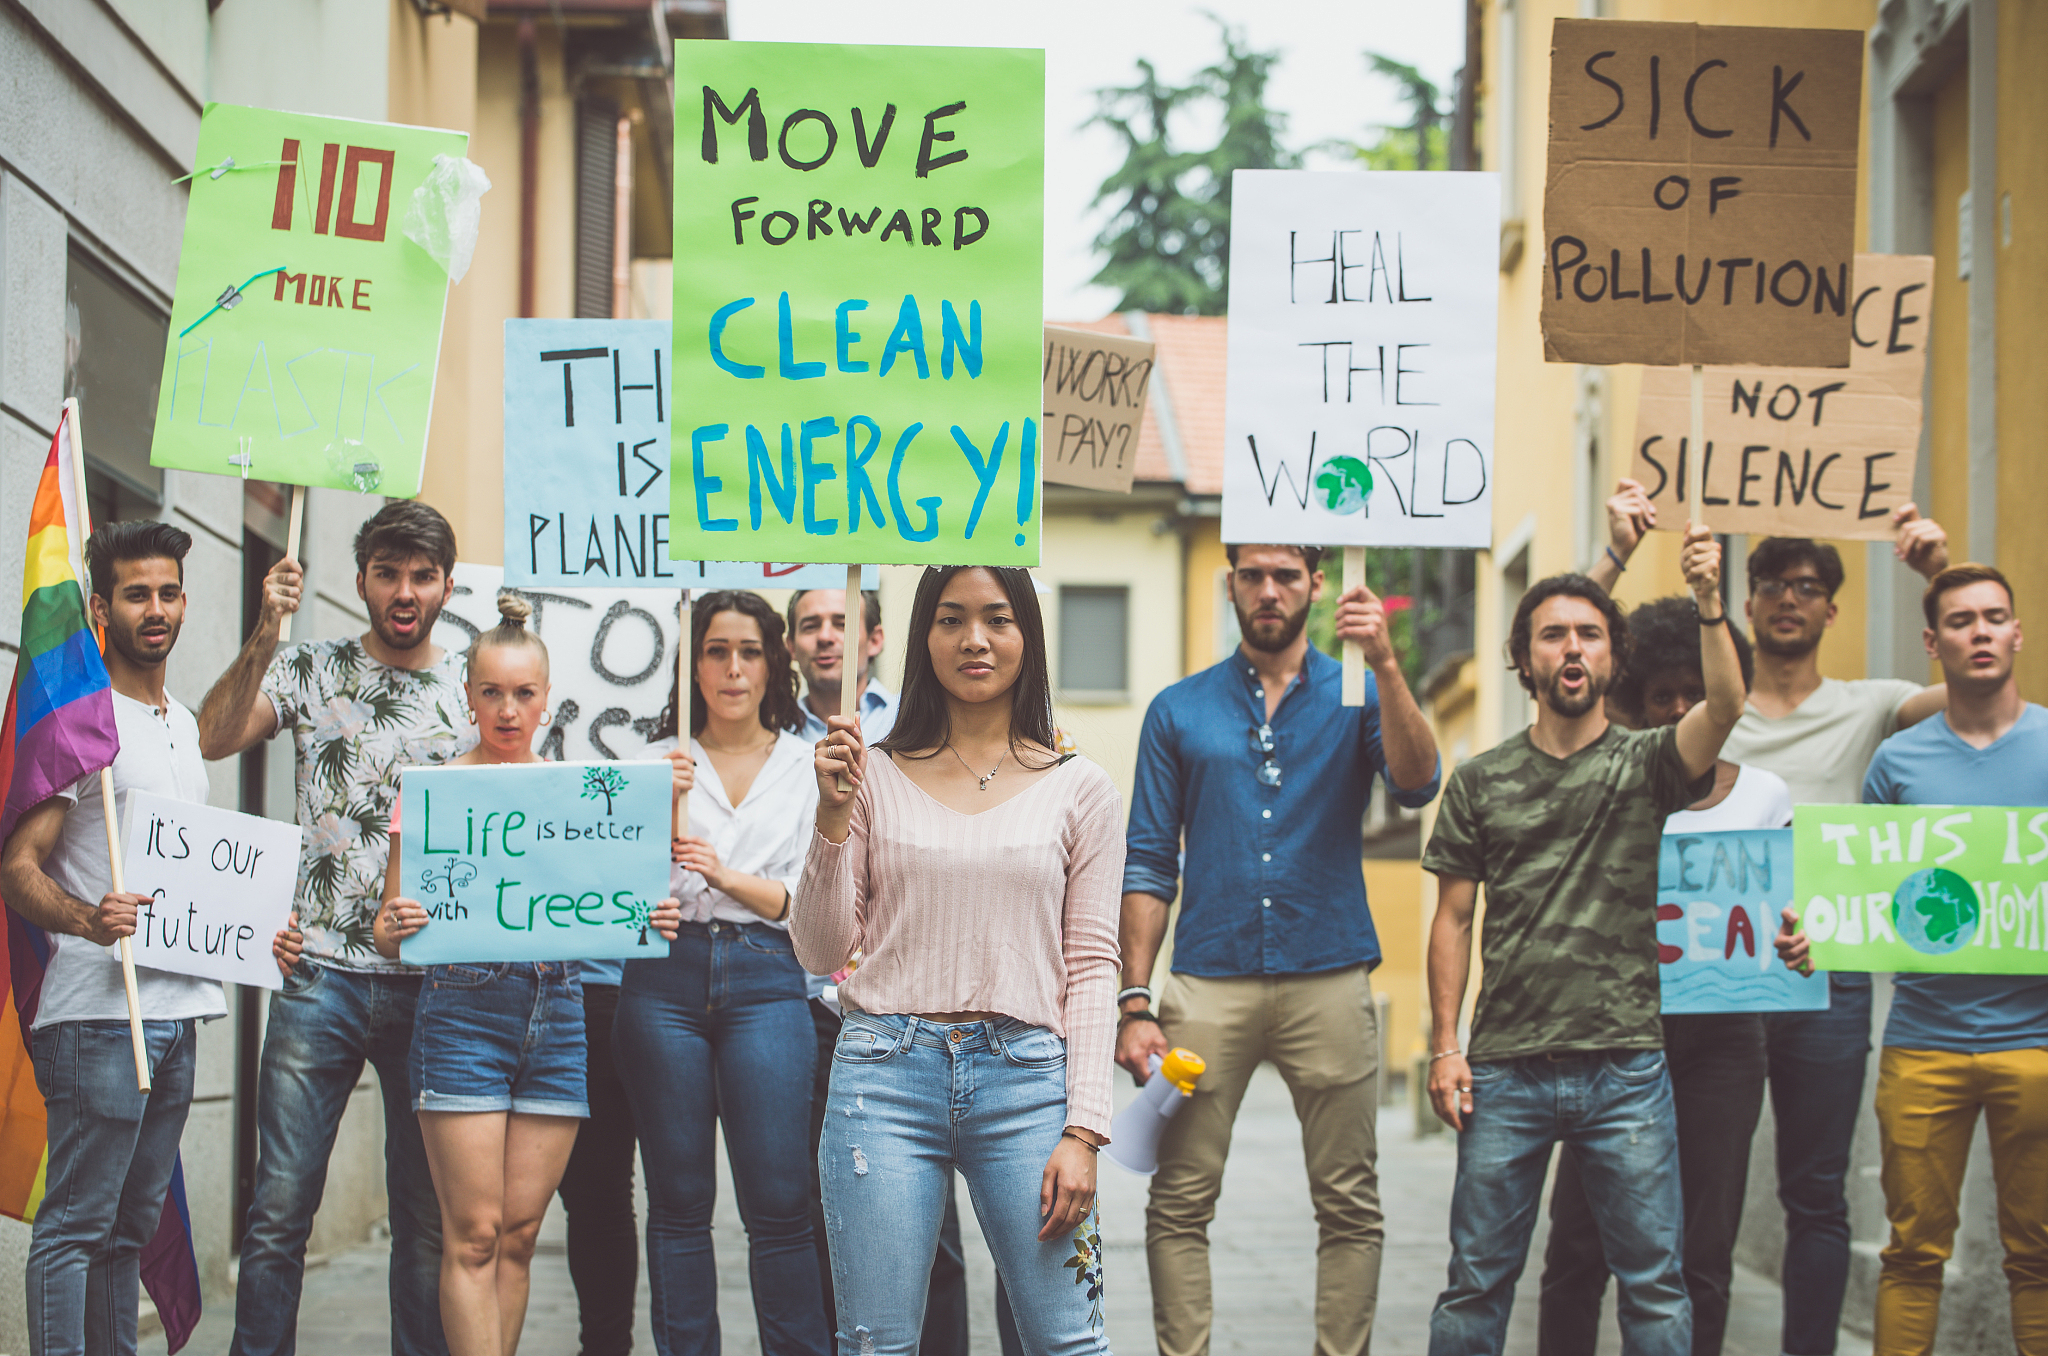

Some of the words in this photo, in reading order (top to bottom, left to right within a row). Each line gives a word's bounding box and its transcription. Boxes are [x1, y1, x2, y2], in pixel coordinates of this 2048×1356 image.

[701, 85, 969, 178] MOVE
[1579, 50, 1812, 150] SICK
[271, 137, 396, 242] NO
[731, 196, 990, 251] FORWARD
[1653, 175, 1744, 217] OF
[273, 269, 372, 312] MORE
[1290, 229, 1433, 304] HEAL
[1550, 234, 1848, 317] POLLUTION
[709, 291, 983, 381] CLEAN
[1298, 341, 1441, 406] THE
[1731, 379, 1848, 427] NOT
[617, 438, 664, 498] IS
[1056, 413, 1132, 470] PAY?
[691, 415, 1037, 547] ENERGY!
[1640, 435, 1897, 520] SILENCE
[529, 512, 705, 578] PLANE
[440, 584, 681, 687] STO
[147, 812, 191, 860] it's
[211, 838, 264, 879] our
[424, 788, 526, 857] Life
[537, 820, 556, 841] is
[564, 820, 644, 841] better
[1820, 811, 1973, 866] THIS
[2001, 811, 2048, 866] IS
[144, 888, 255, 960] future
[496, 877, 637, 932] trees
[1803, 891, 1897, 945] OUR
[1971, 880, 2048, 952] HOM
